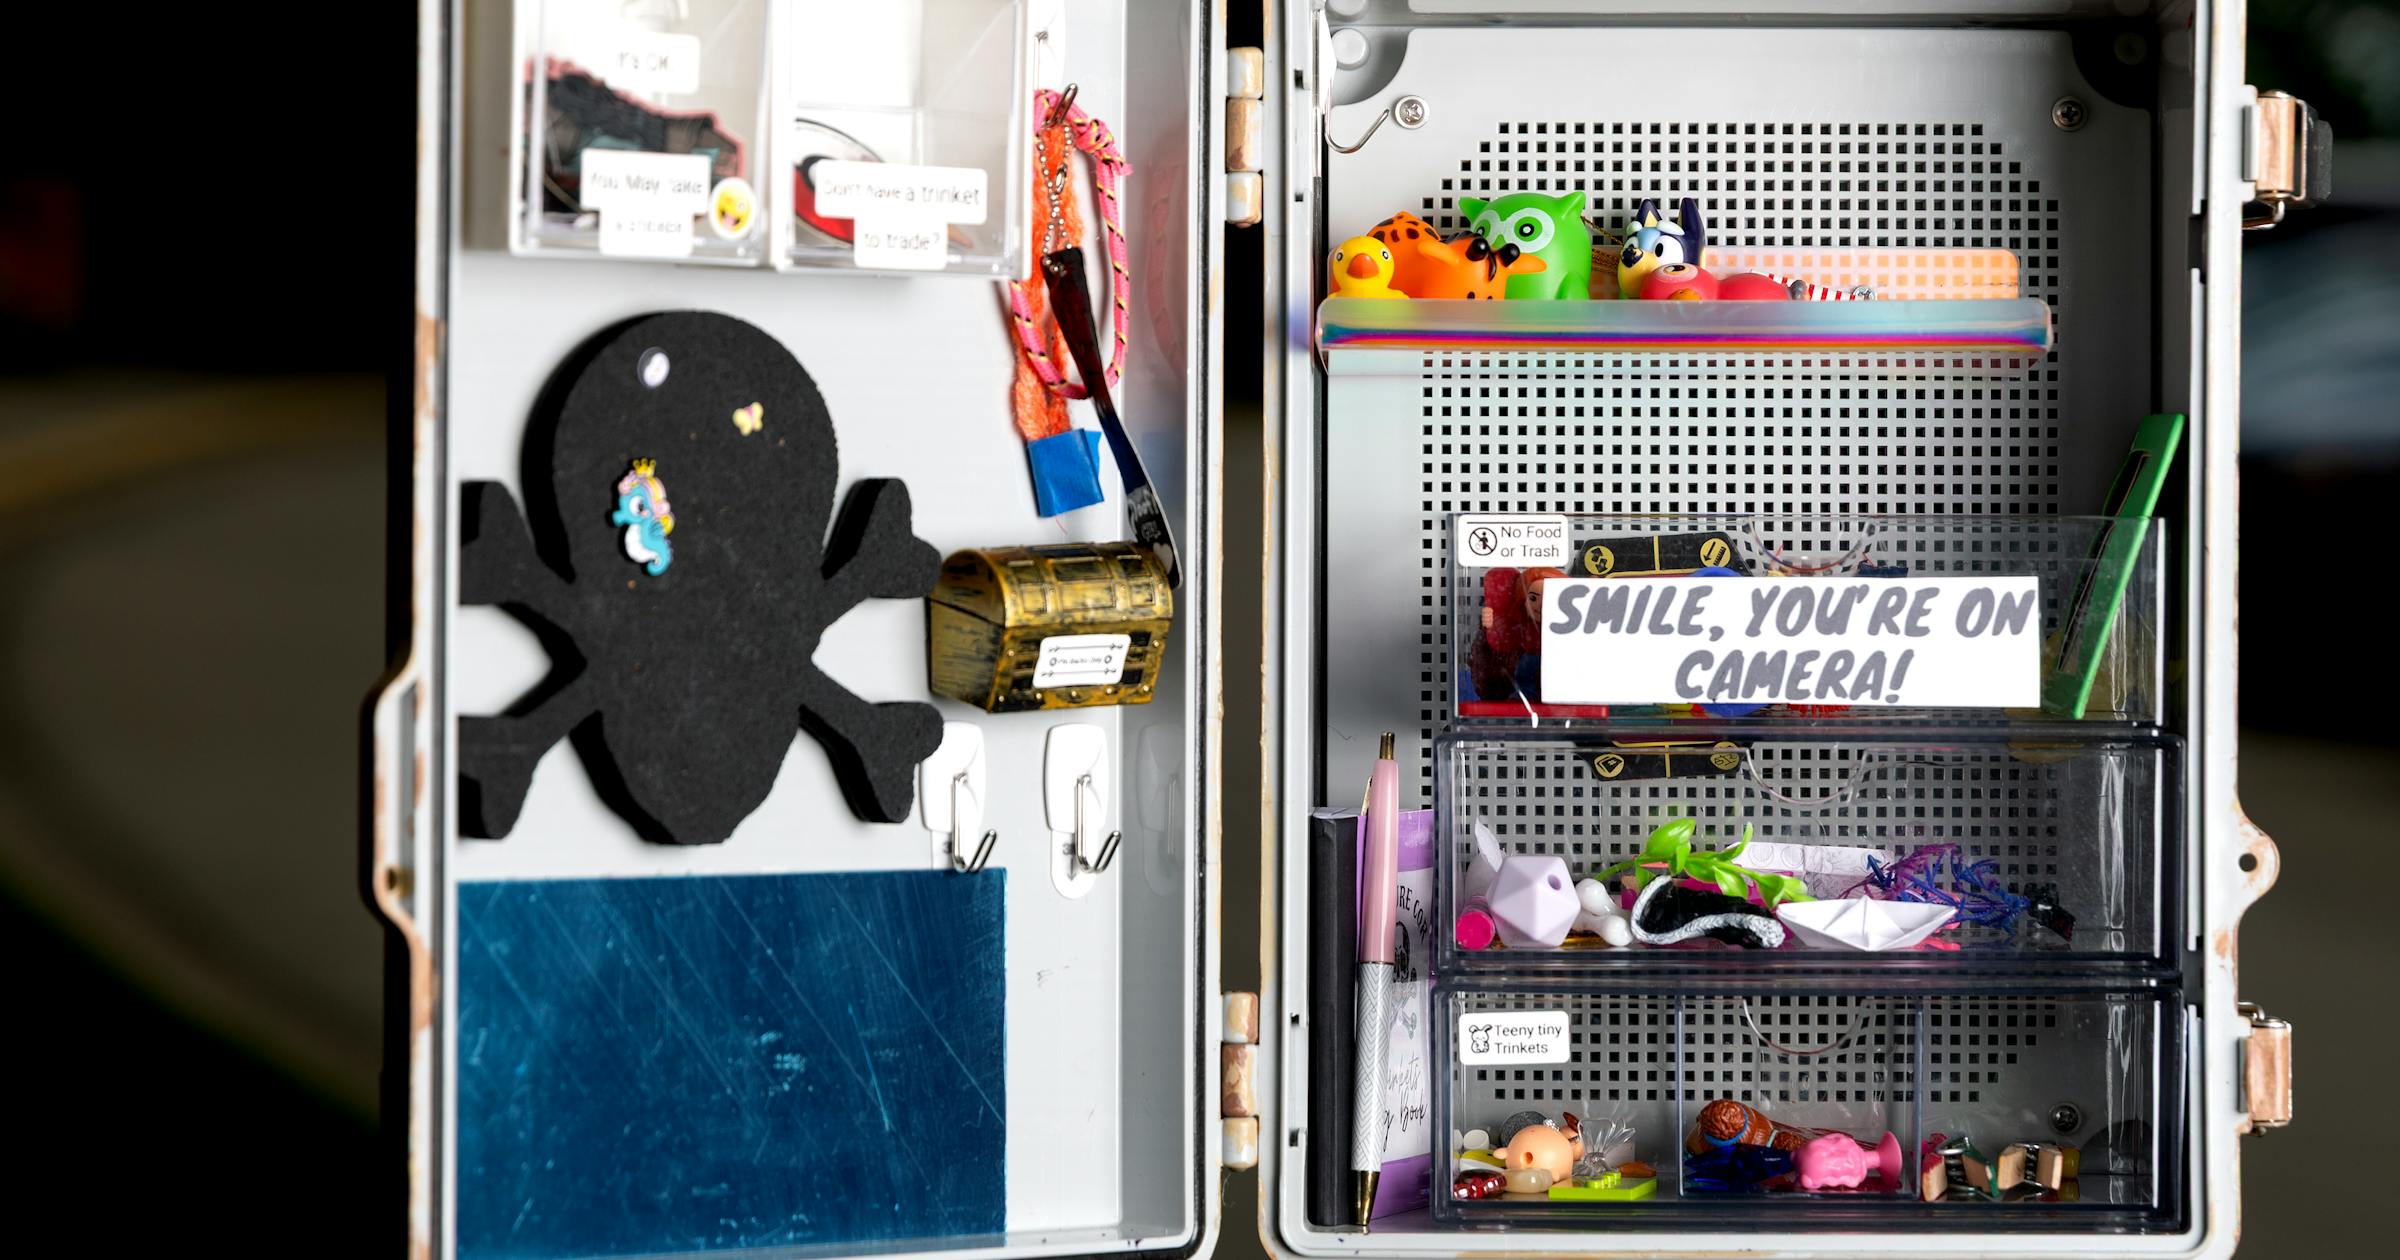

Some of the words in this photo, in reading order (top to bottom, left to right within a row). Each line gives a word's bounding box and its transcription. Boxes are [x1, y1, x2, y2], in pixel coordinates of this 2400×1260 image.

[905, 187, 915, 202] a
[921, 185, 980, 205] trinket
[863, 232, 880, 249] to
[1500, 525, 1522, 539] No
[1526, 525, 1562, 539] Food
[1500, 547, 1516, 557] or
[1519, 544, 1560, 558] Trash
[1548, 583, 1725, 642] SMILE,
[1743, 584, 1942, 638] YOU'RE
[1955, 586, 2037, 639] ON
[1674, 648, 1915, 705] CAMERA!
[1494, 1024, 1535, 1040] Teeny
[1538, 1023, 1562, 1039] tiny
[1494, 1041, 1549, 1055] Trinkets
